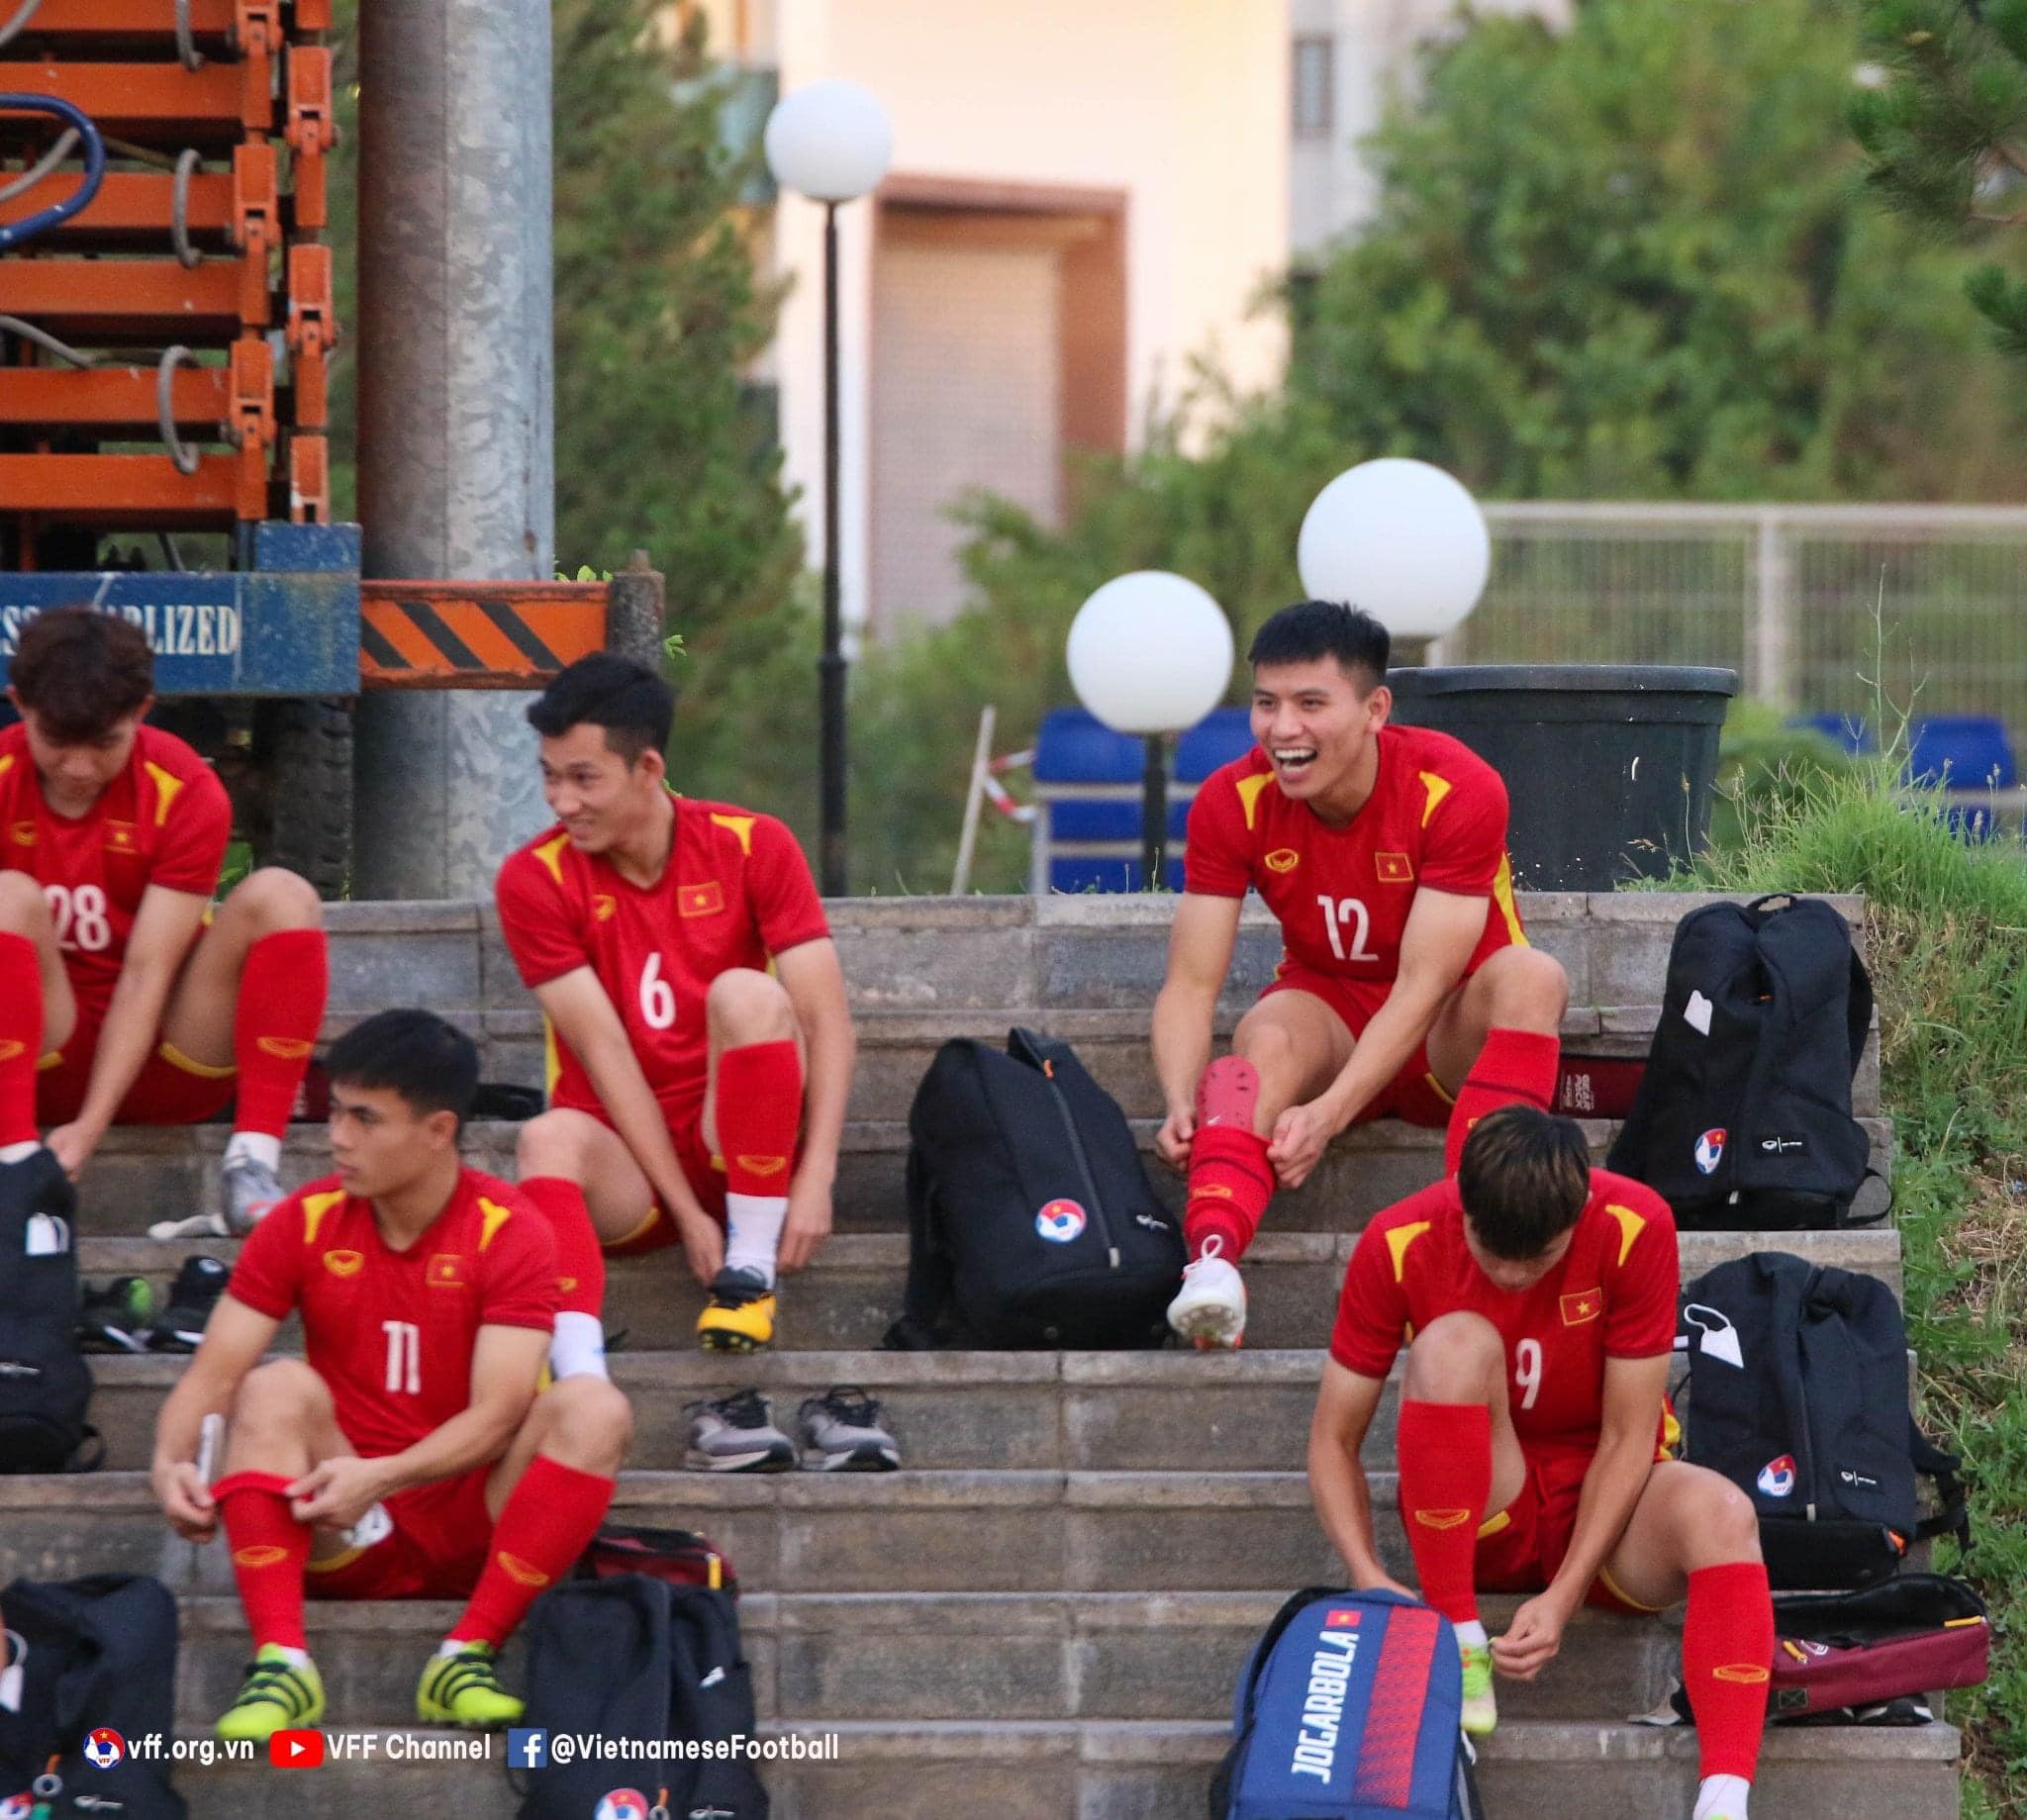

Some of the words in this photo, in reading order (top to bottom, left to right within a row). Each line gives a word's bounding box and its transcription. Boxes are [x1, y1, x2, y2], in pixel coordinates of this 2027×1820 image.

[44, 884, 111, 951] 28
[1316, 894, 1379, 961] 12
[639, 951, 676, 1029] 6
[381, 1319, 421, 1394] 11
[1515, 1337, 1541, 1409] 9
[1291, 1631, 1360, 1783] JOGARBOLA
